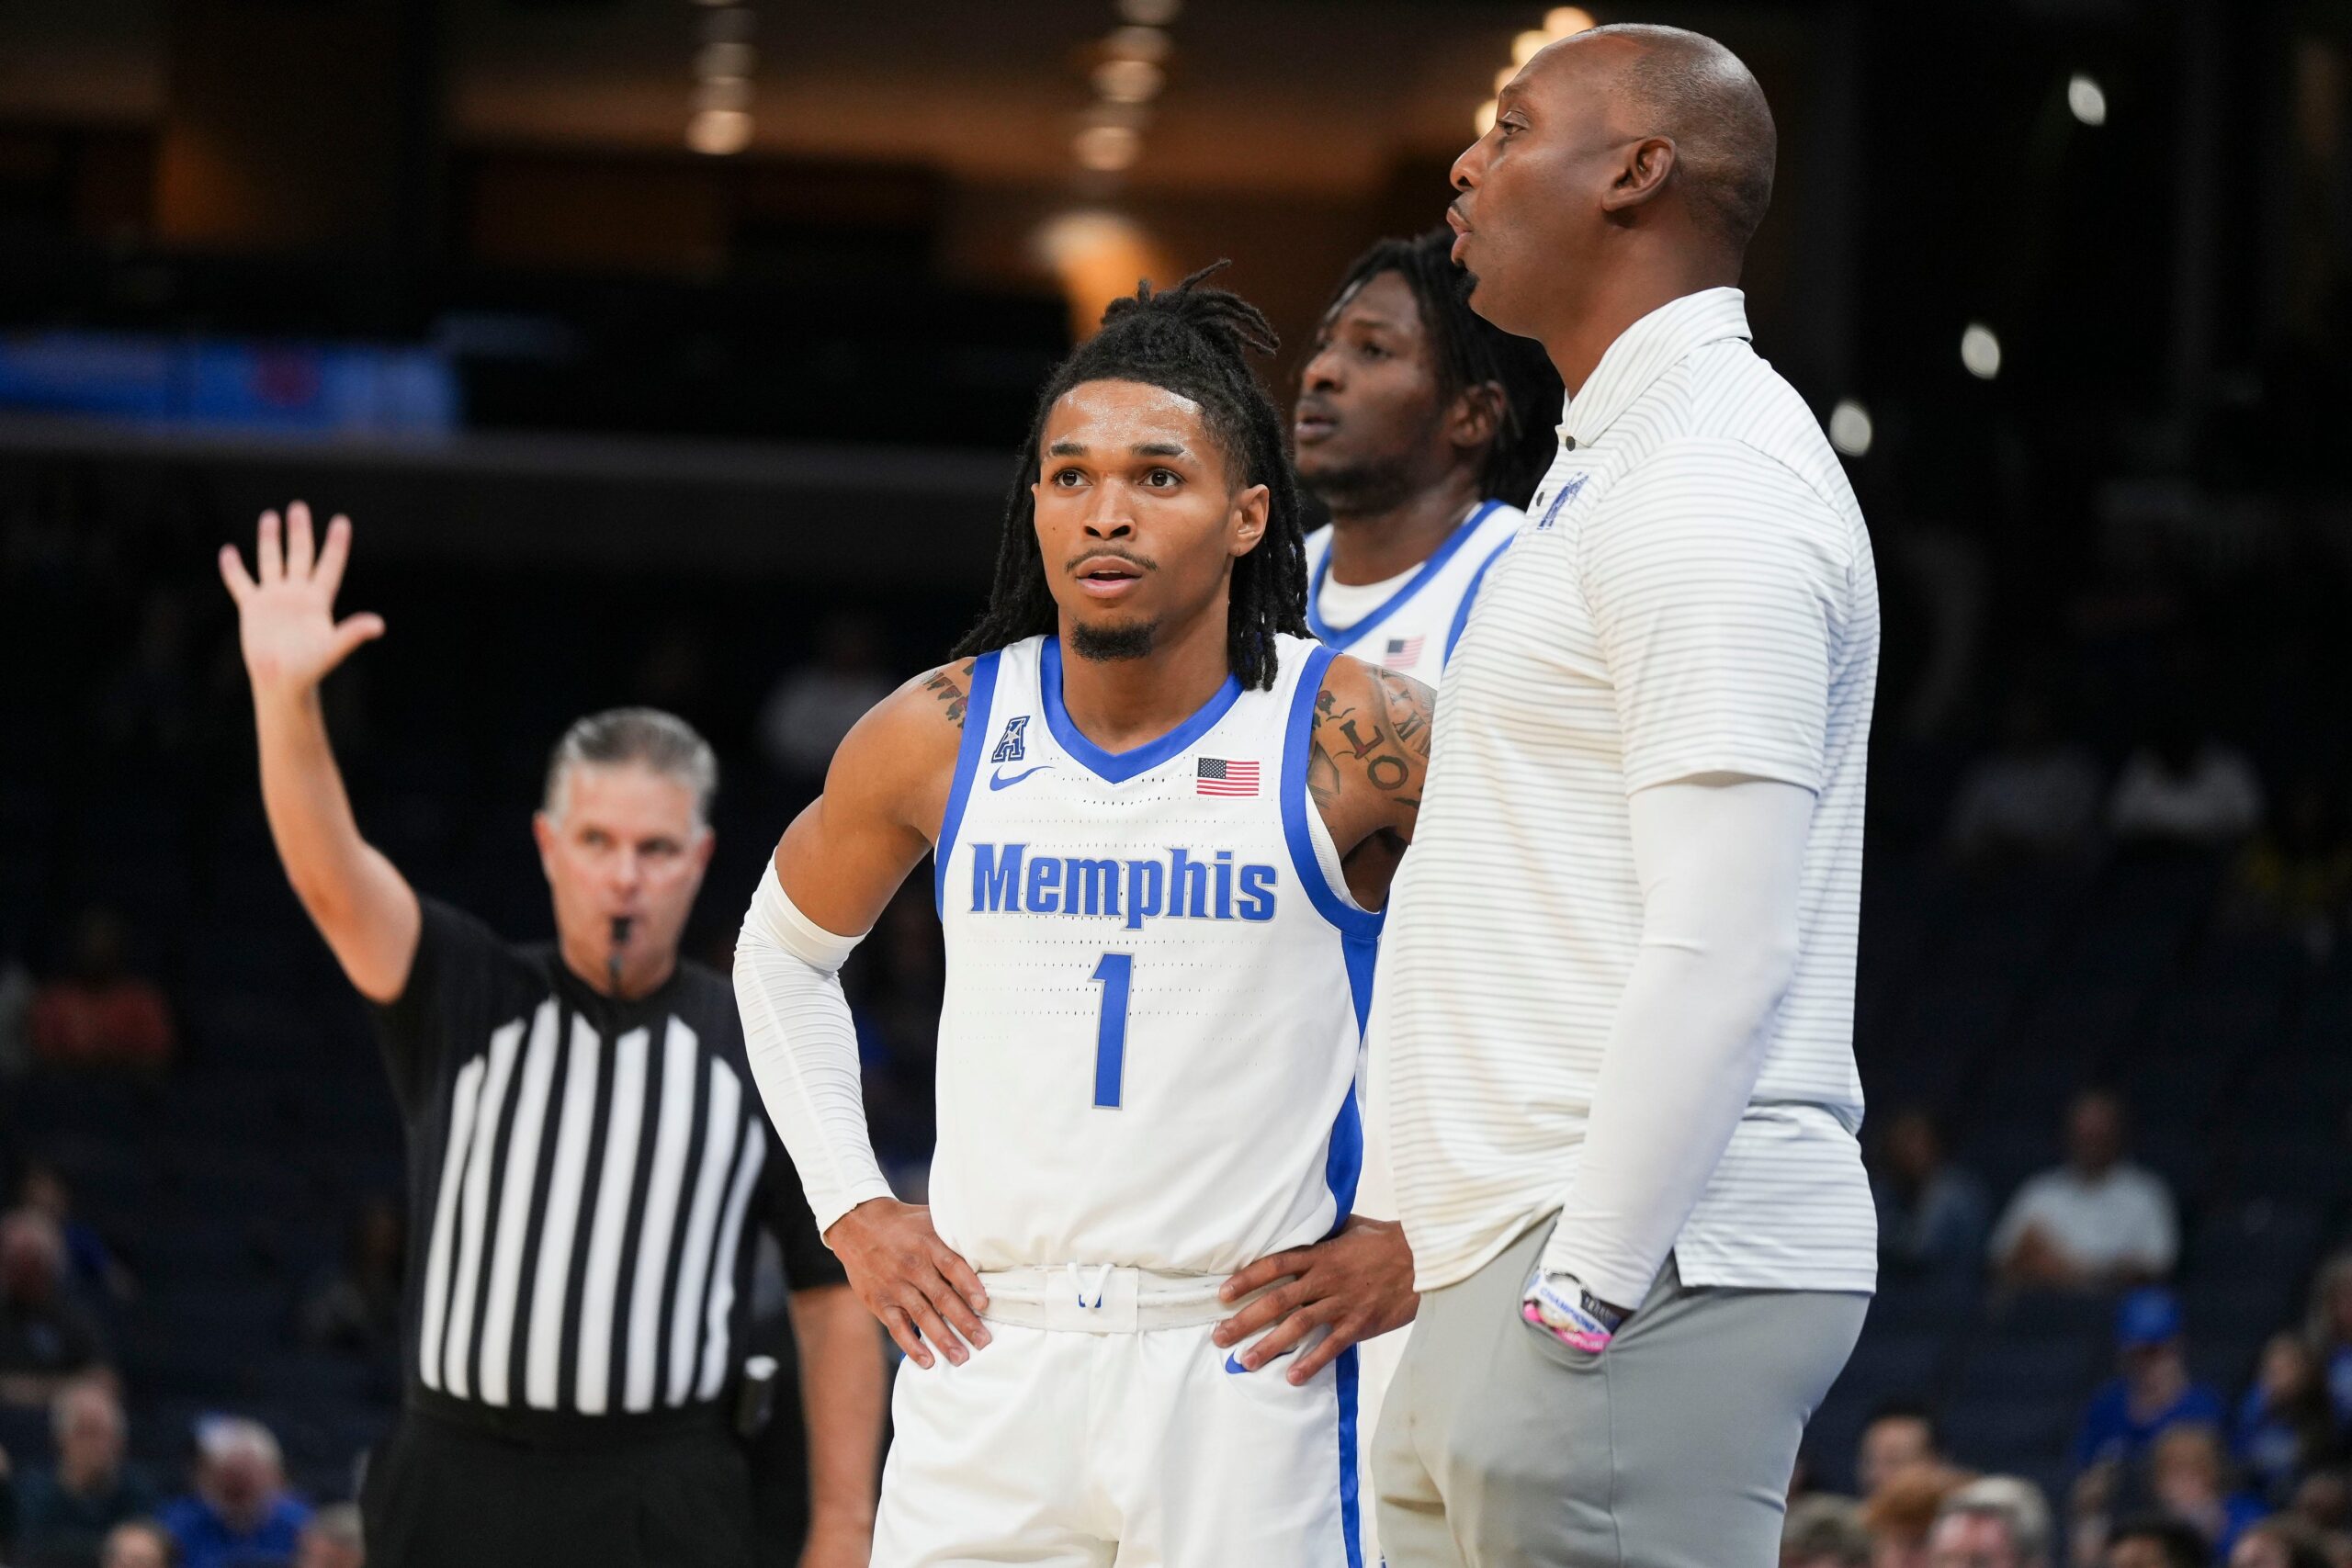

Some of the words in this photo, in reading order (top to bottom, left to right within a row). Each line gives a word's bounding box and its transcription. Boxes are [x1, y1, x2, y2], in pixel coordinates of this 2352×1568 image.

[991, 716, 1030, 763] A
[967, 842, 1279, 931] Memphis
[1088, 952, 1135, 1111] 1
